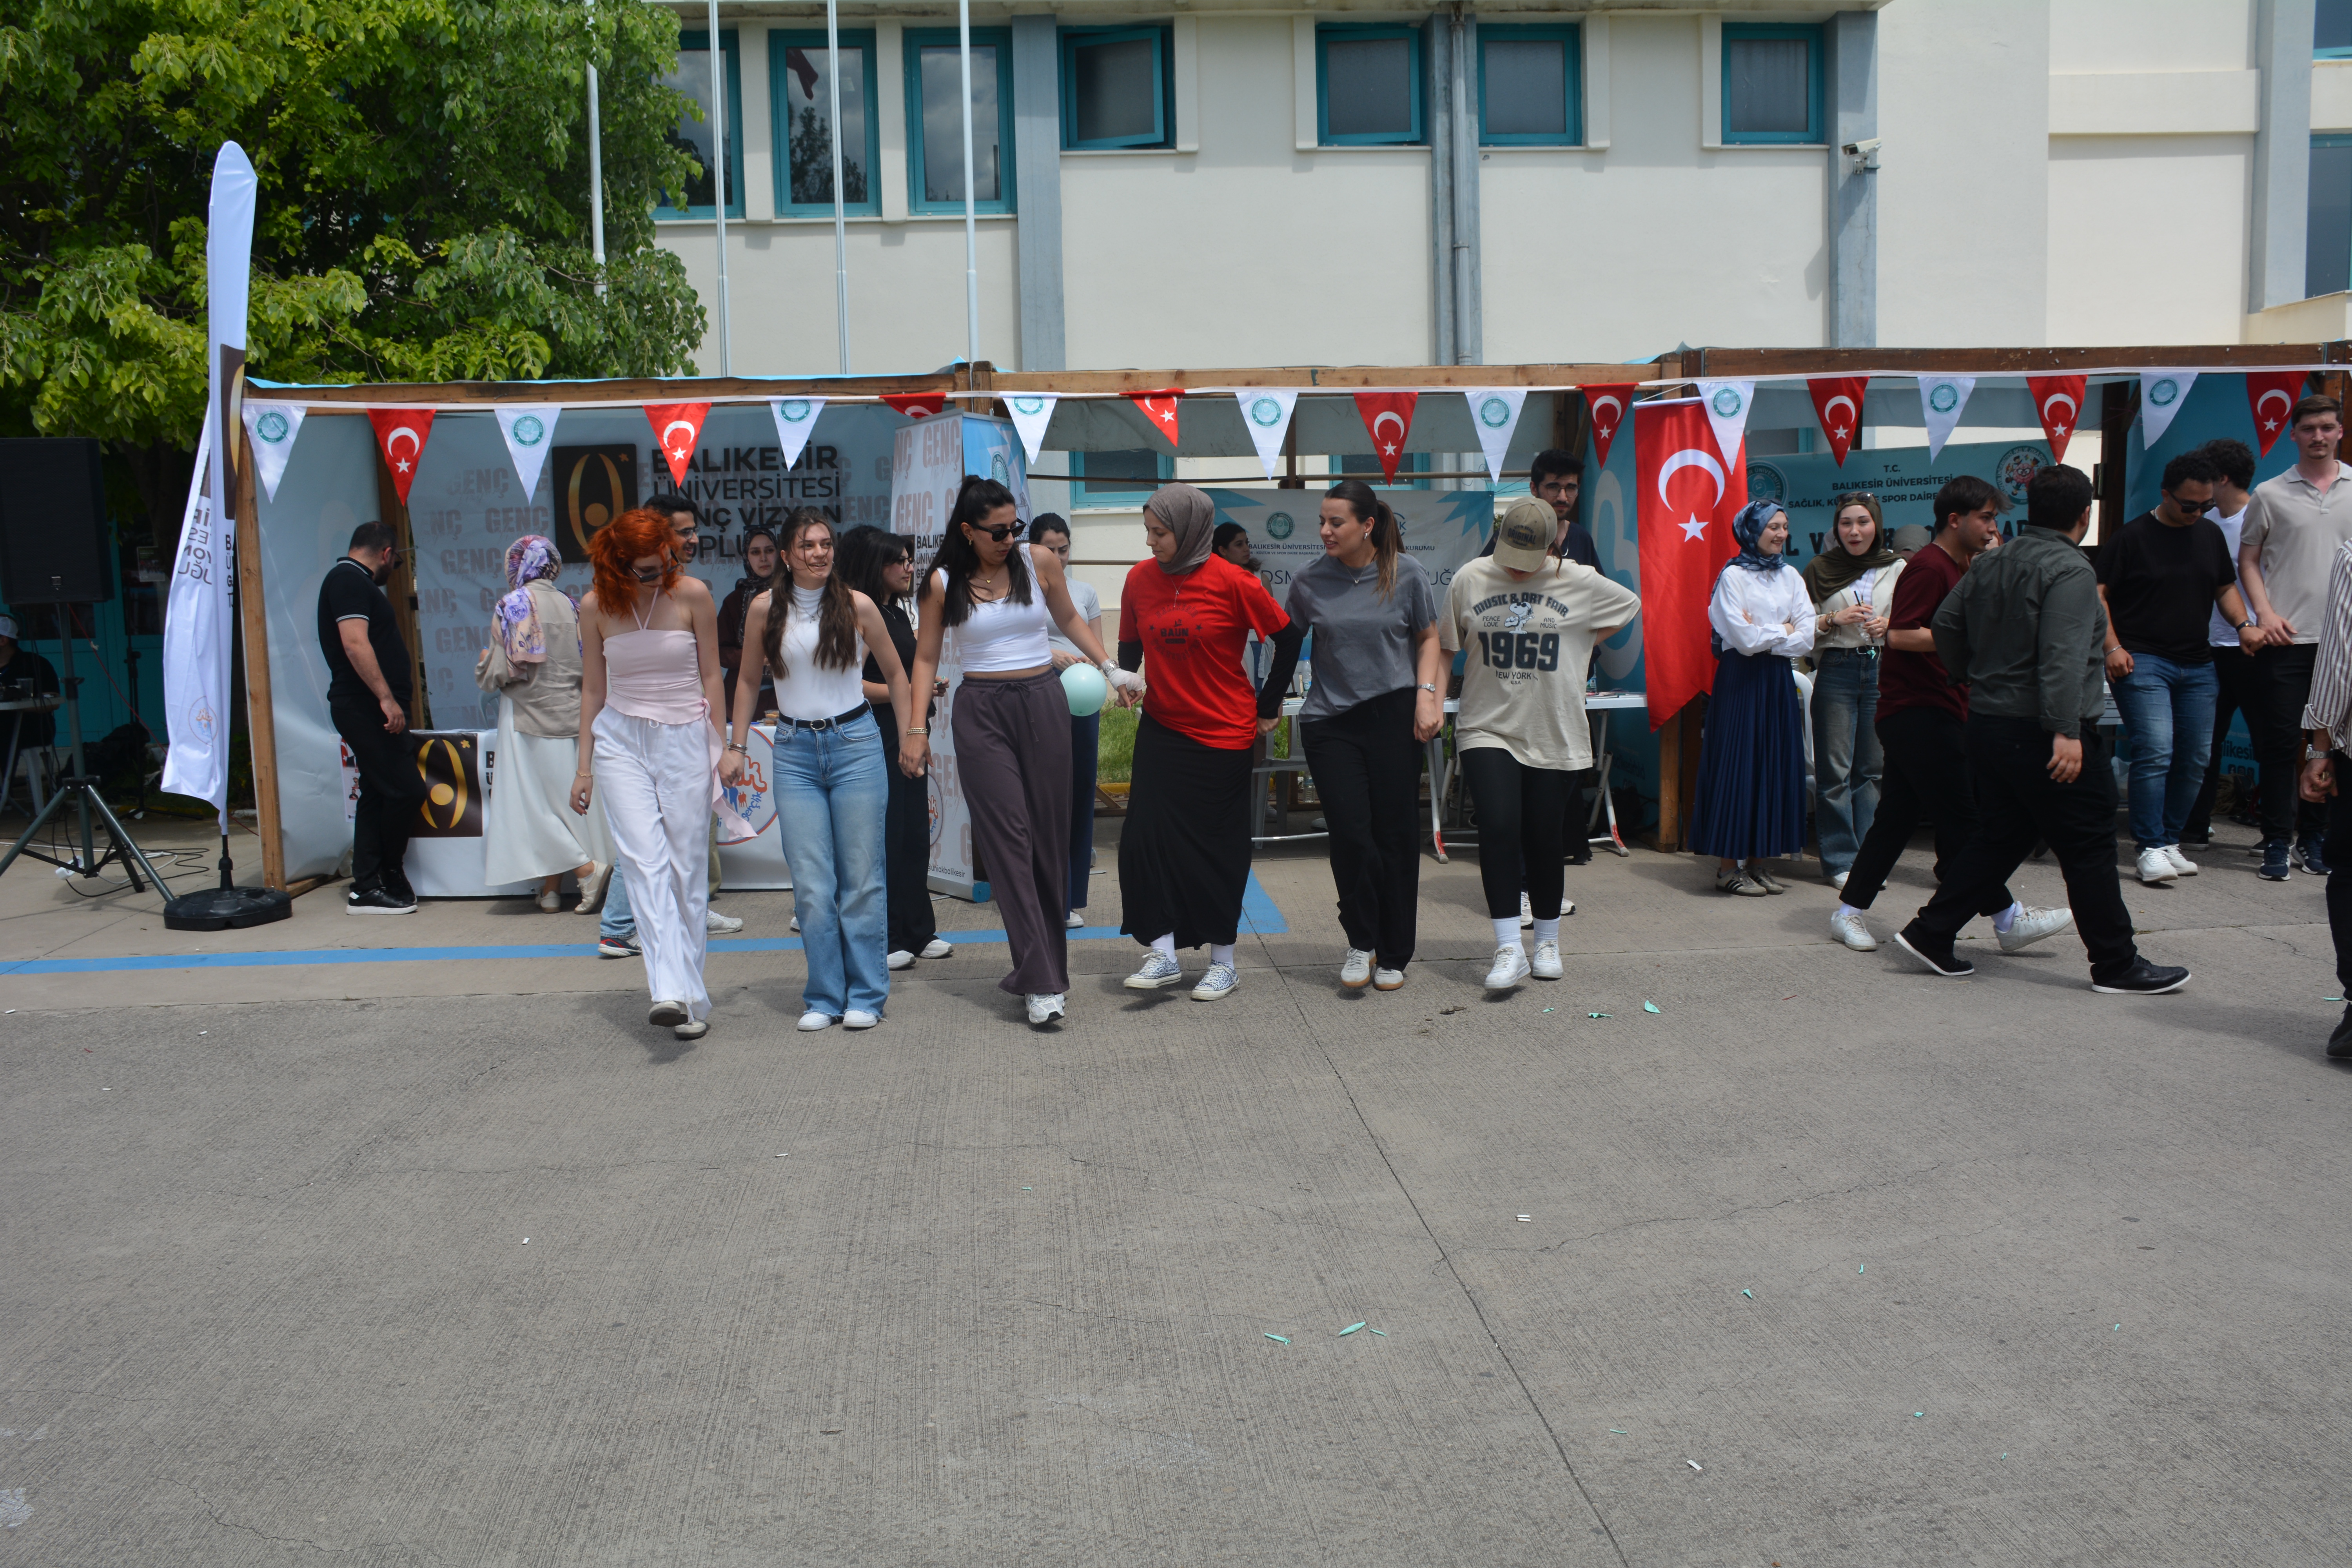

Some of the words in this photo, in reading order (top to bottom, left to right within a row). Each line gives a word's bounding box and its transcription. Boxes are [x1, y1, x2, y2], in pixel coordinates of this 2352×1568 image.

[923, 419, 960, 472] GENÇ
[1832, 478, 1883, 490] BALIKESİR
[1886, 474, 1953, 487] ÜNİVERSİTESİ
[1883, 465, 1900, 473] T.C.
[1788, 498, 1825, 508] SAĞLIK,
[485, 506, 549, 536] GENÇ
[1508, 528, 1536, 545] ORIGINAL
[441, 548, 503, 578] GENÇ
[1472, 593, 1509, 617] MUSIC
[1510, 593, 1521, 604] &
[1521, 592, 1544, 605] ART
[1545, 596, 1569, 619] FAIR
[1477, 631, 1560, 672] 1969
[1511, 671, 1532, 680] YORK
[741, 791, 762, 822] gençlik
